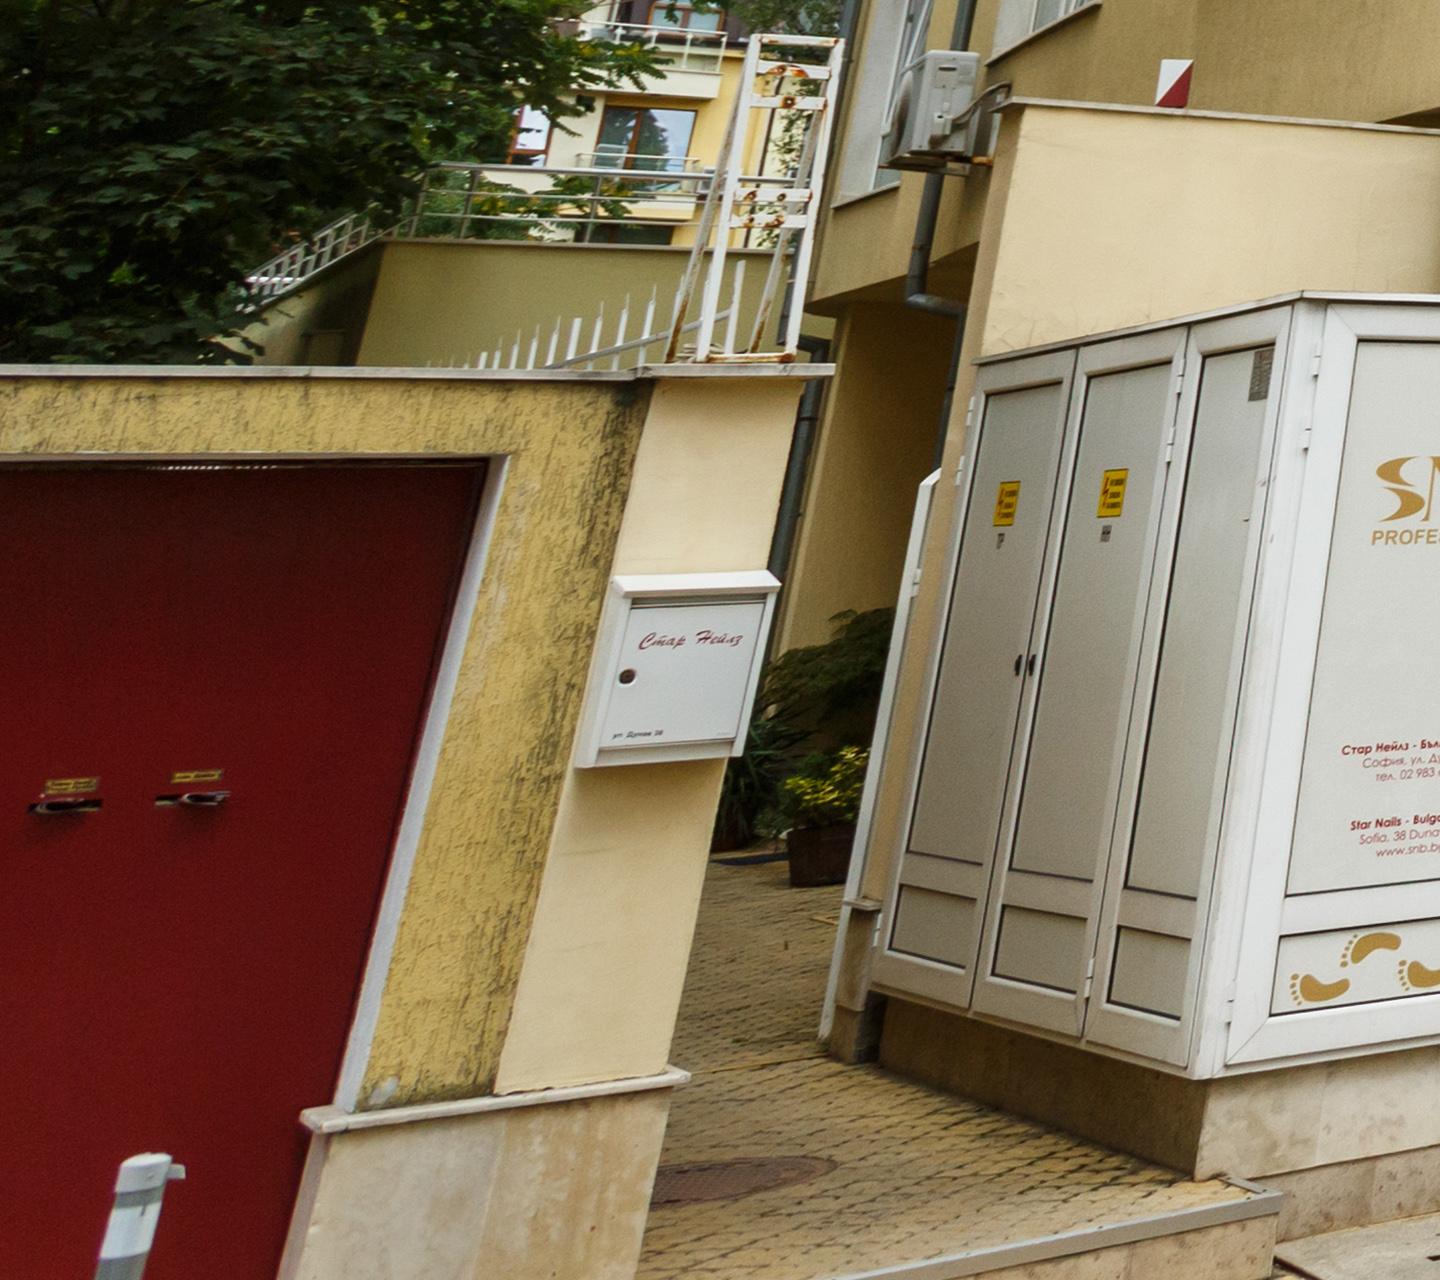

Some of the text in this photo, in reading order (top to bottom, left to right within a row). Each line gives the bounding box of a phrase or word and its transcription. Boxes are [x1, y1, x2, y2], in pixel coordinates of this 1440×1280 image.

[638, 631, 687, 651] Стар
[1341, 744, 1372, 756] Стар
[1376, 740, 1409, 753] Нейлз
[1399, 768, 1413, 781] 02
[1416, 766, 1436, 778] 983
[1350, 819, 1372, 831] Star
[1375, 815, 1402, 828] Nails
[1393, 830, 1406, 842] 38
